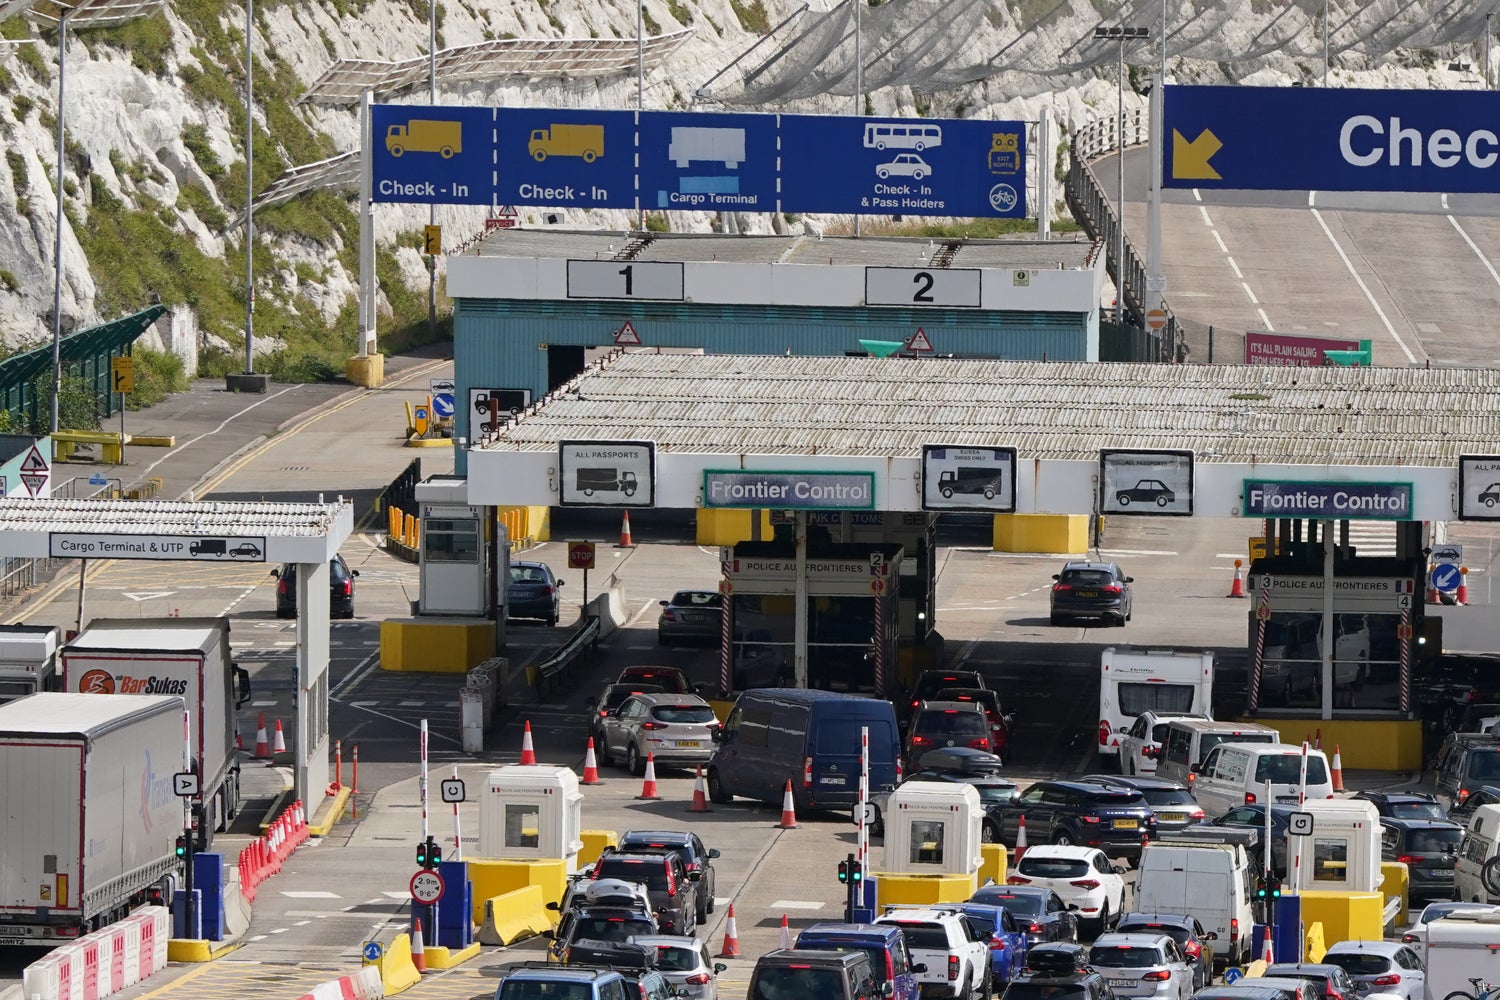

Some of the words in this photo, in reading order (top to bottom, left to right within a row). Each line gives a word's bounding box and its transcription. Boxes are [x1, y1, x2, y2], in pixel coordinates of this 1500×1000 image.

[379, 179, 436, 197] Check
[452, 182, 469, 197] In
[519, 183, 575, 200] Check
[591, 185, 608, 201] In
[873, 183, 910, 195] Check
[920, 184, 932, 196] In
[669, 192, 706, 206] Cargo
[708, 192, 758, 205] Terminal
[861, 197, 870, 208] &
[872, 197, 899, 208] Pass
[901, 198, 945, 209] Holders
[618, 265, 633, 296] 1
[913, 271, 934, 302] 2
[1250, 342, 1262, 353] IT'S
[1262, 344, 1274, 354] ALL
[1274, 344, 1292, 356] PLAIN
[1293, 346, 1317, 358] SAILING
[575, 451, 591, 459] ALL
[592, 451, 640, 459] PASSPORTS
[1474, 464, 1489, 472] ALL
[710, 480, 790, 499] Frontier
[794, 482, 867, 500] Control
[1250, 489, 1328, 509] Frontier
[1332, 491, 1406, 510] Control
[60, 540, 96, 554] Cargo
[99, 540, 147, 552] Terminal
[150, 542, 158, 552] &
[161, 543, 184, 553] UTP
[571, 551, 592, 560] STOP
[724, 548, 731, 561] 1
[871, 554, 882, 566] 2
[747, 562, 781, 572] POLICE
[805, 563, 864, 573] FRONTIERES
[1262, 576, 1271, 588] 3
[1272, 580, 1308, 590] POLICE
[1400, 596, 1410, 607] 4
[119, 675, 188, 695] BarSukas
[181, 779, 192, 789] A
[448, 786, 459, 796] C
[1295, 819, 1307, 829] G
[418, 876, 438, 885] 2.9m
